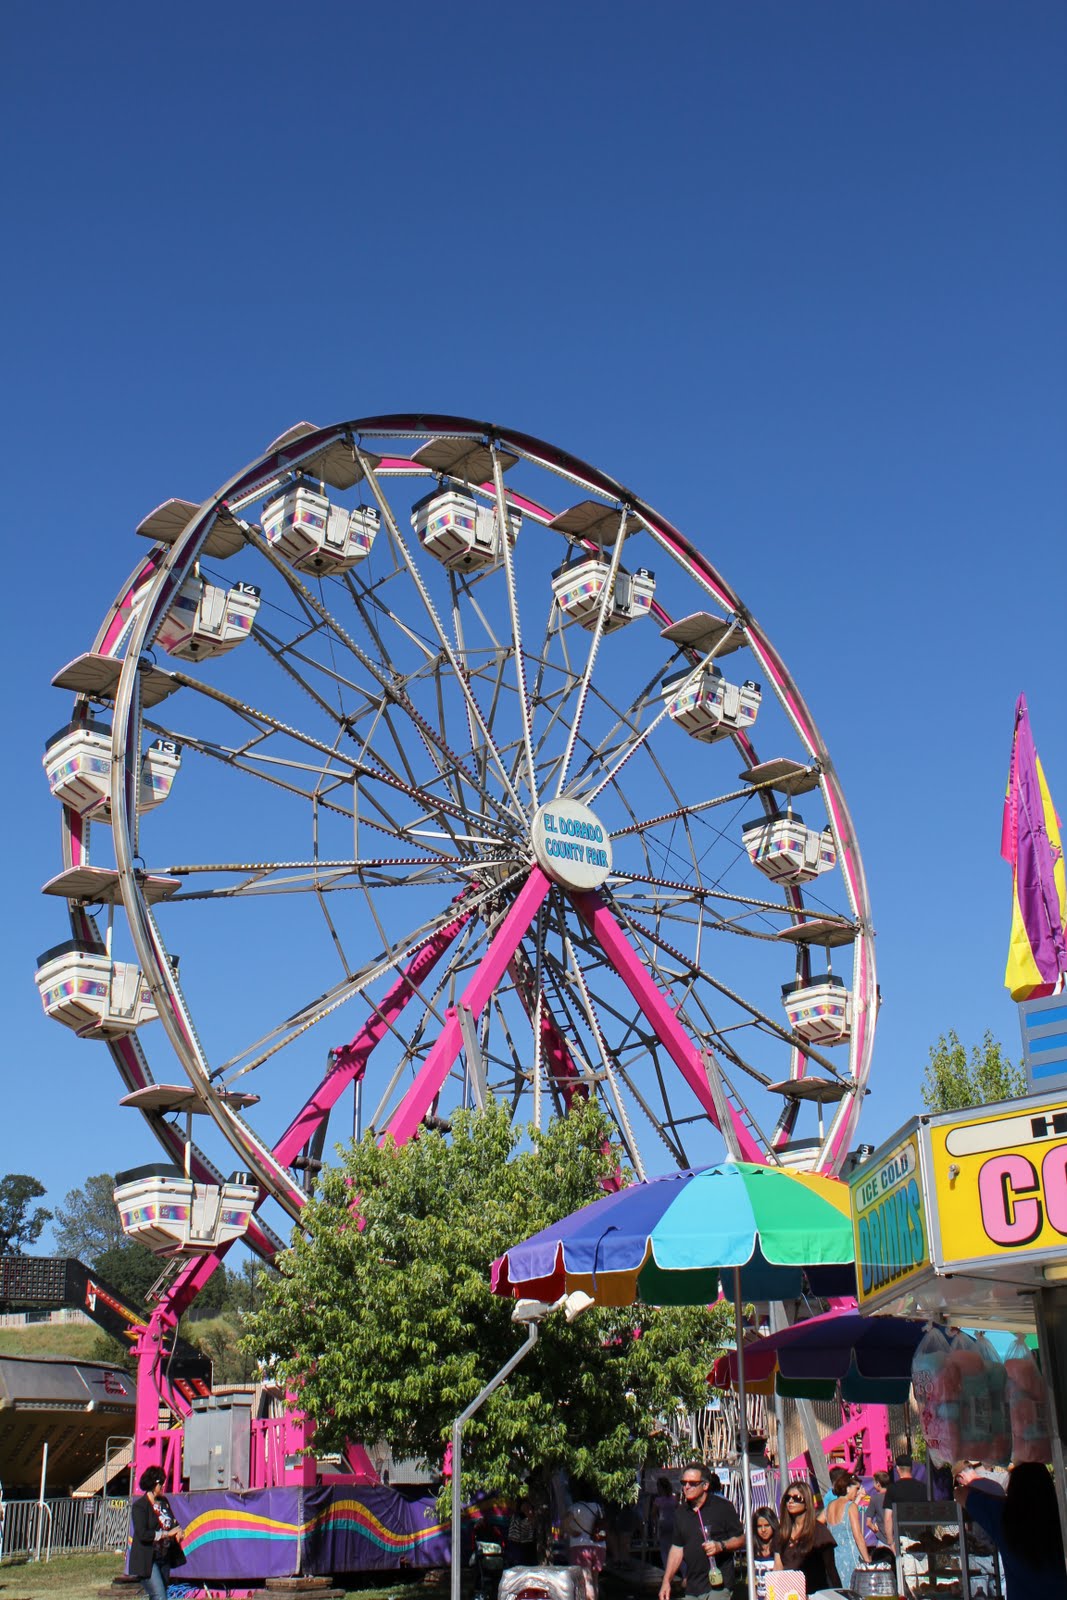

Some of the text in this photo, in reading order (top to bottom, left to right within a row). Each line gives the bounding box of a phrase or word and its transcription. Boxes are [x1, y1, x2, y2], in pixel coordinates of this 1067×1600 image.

[640, 568, 649, 579] 2
[239, 582, 256, 595] 14
[747, 680, 756, 691] 3
[157, 740, 176, 753] 13
[543, 813, 603, 843] EL DORADO
[545, 838, 608, 868] COUNTY FAIR
[235, 1172, 247, 1185] 11
[862, 1153, 909, 1206] ICE COLD
[858, 1178, 925, 1297] DRINKS
